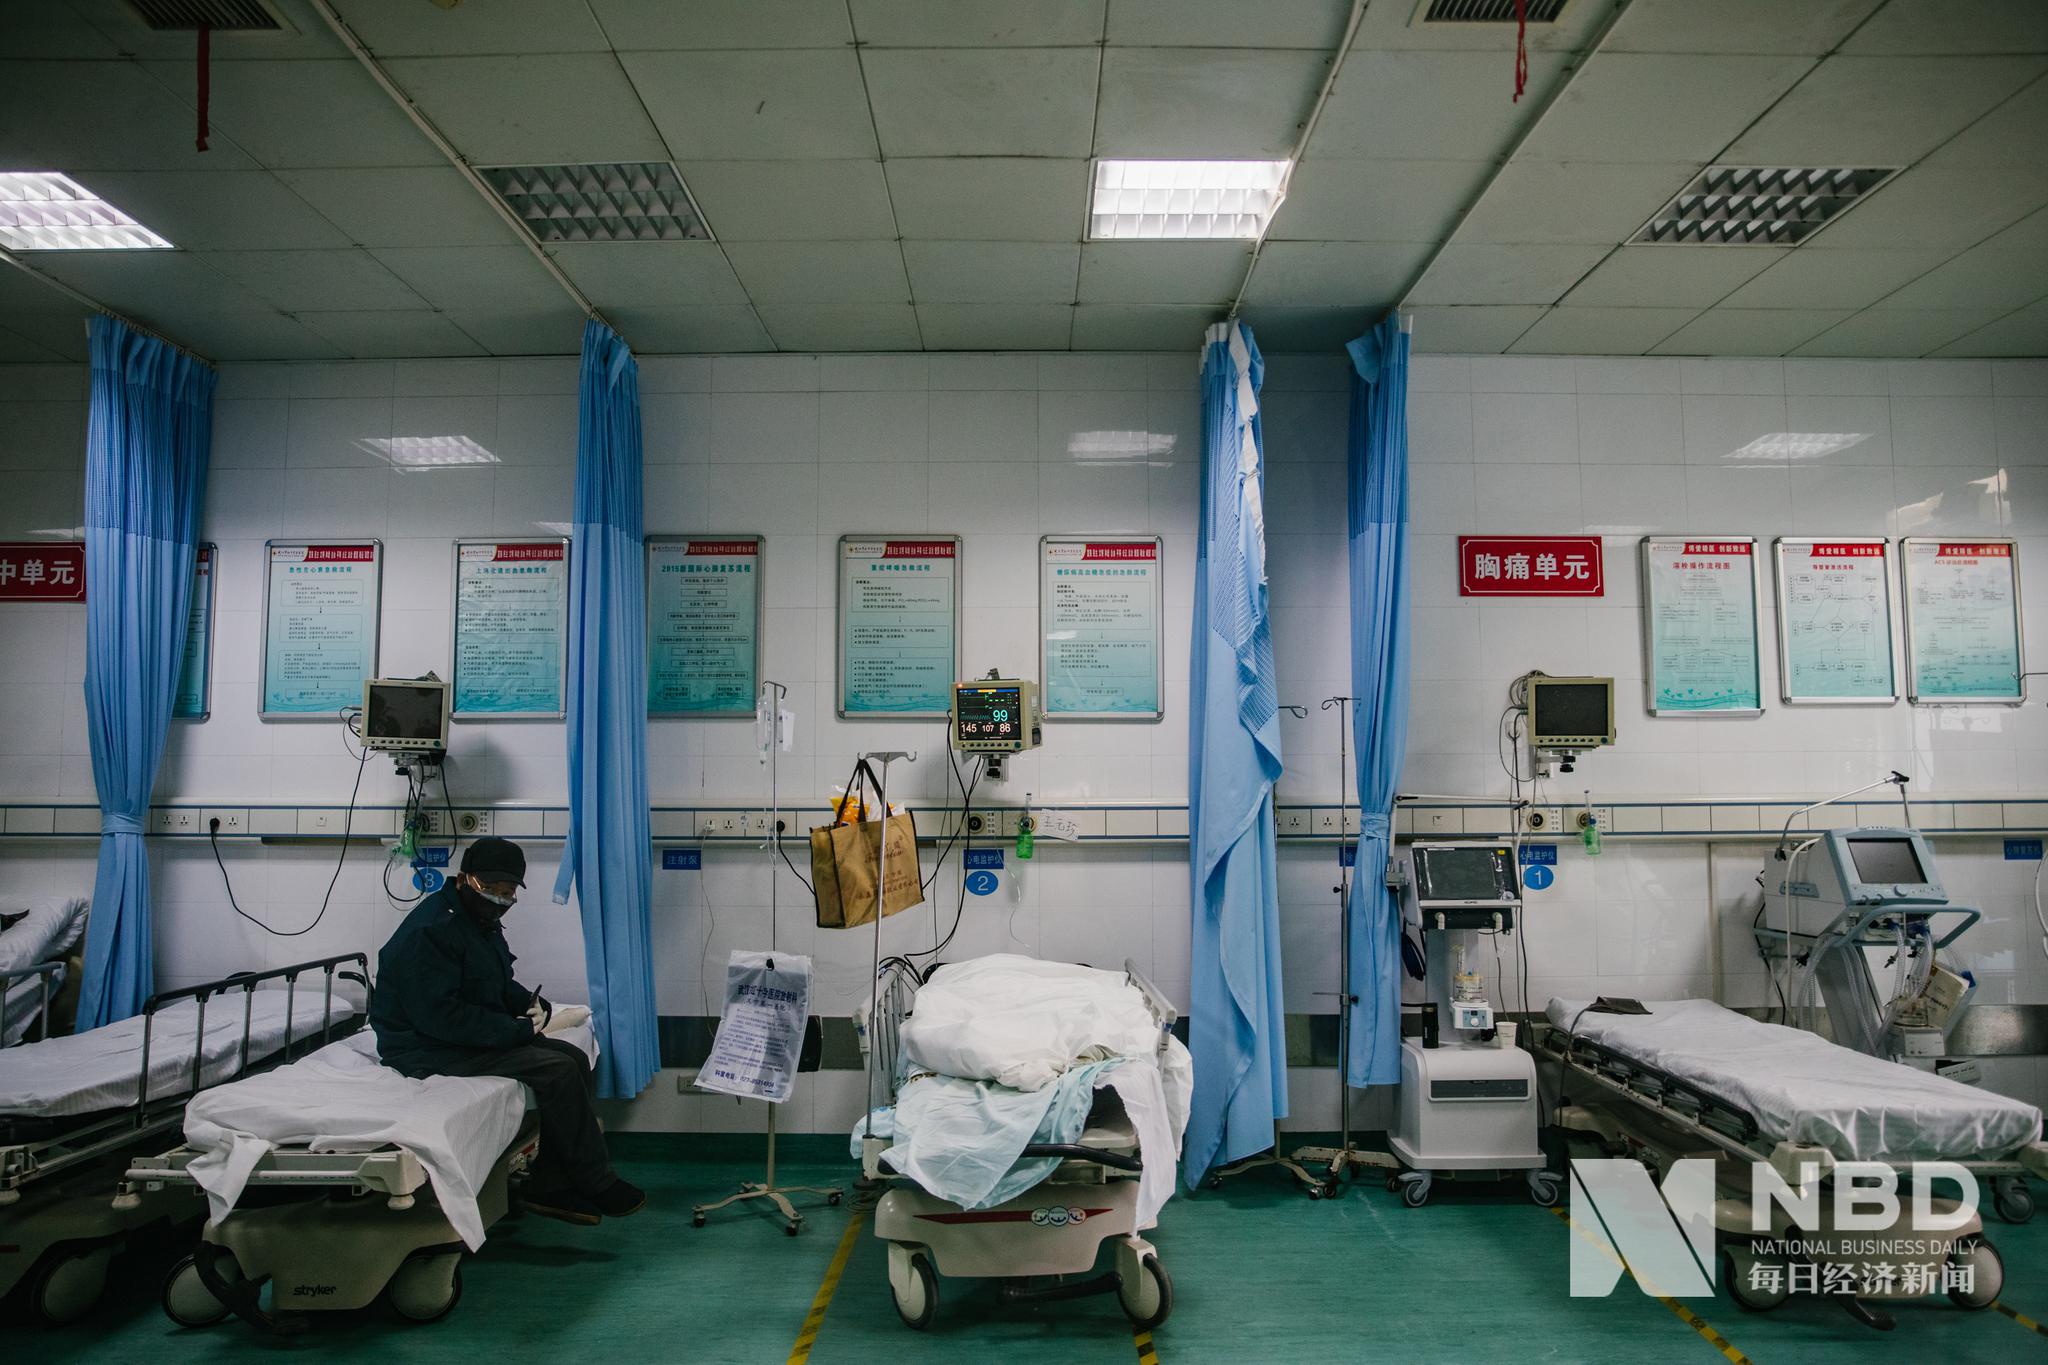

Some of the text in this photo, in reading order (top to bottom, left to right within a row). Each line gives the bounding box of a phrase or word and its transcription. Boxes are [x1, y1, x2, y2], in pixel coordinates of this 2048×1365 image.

[0, 558, 75, 586] 中单元
[1475, 553, 1590, 580] 胸痛单元
[992, 709, 1008, 722] 99
[961, 723, 1011, 733] 145 107 86
[667, 855, 698, 865] 注射泵
[967, 855, 1002, 865] 心电监护仪
[1520, 850, 1555, 860] 心电监护仪
[977, 875, 989, 891] 2
[1535, 870, 1542, 885] 1
[293, 1284, 337, 1297] stryker
